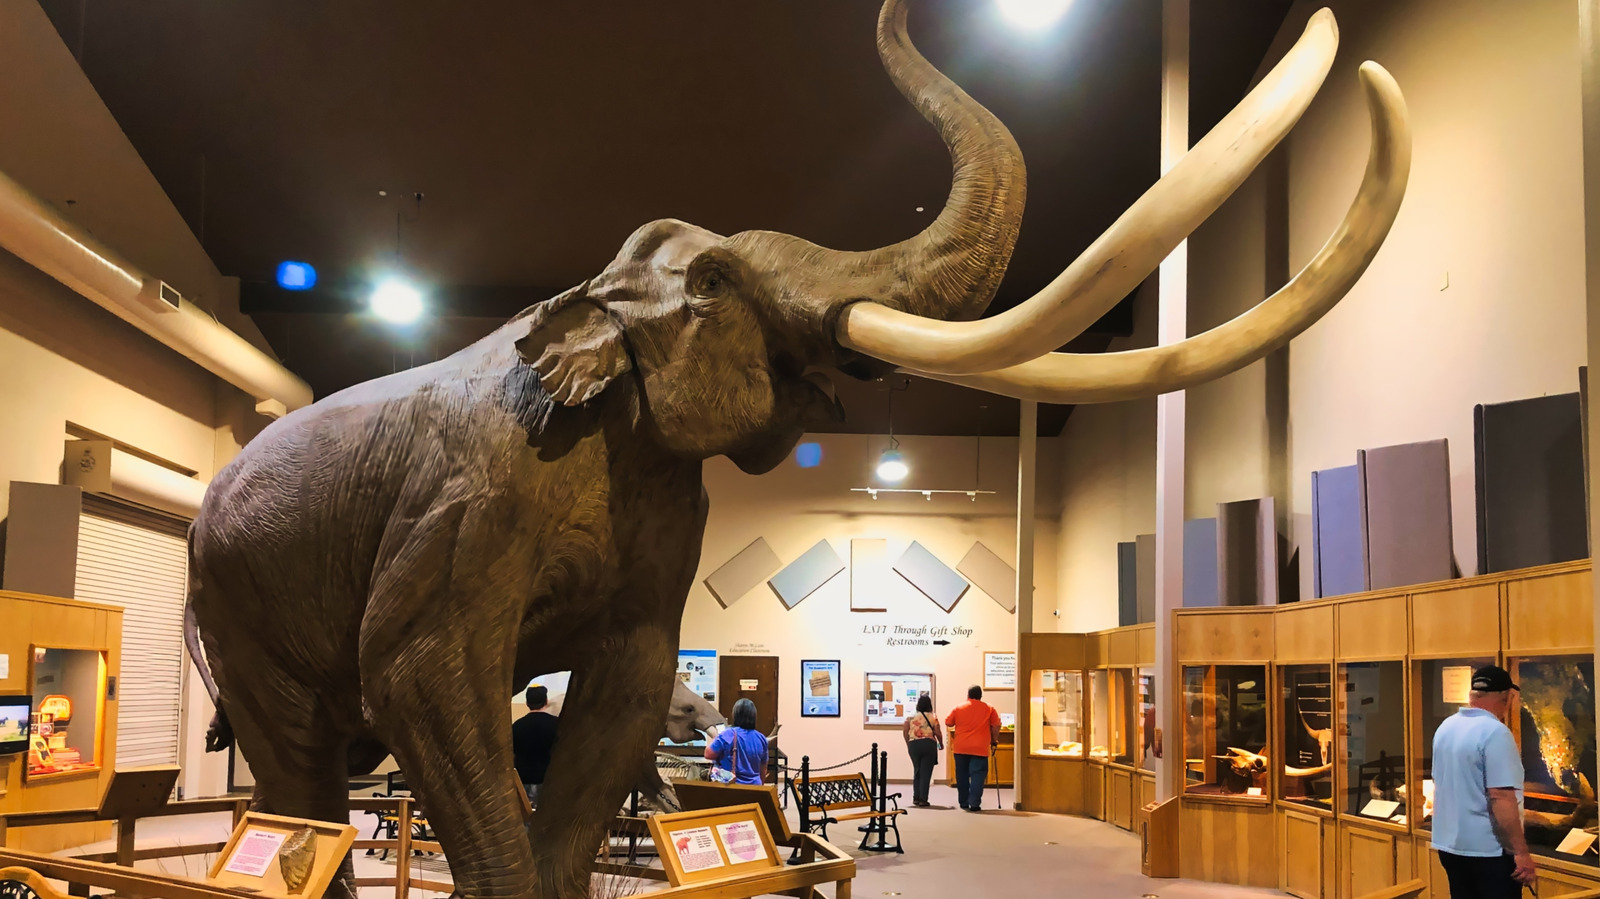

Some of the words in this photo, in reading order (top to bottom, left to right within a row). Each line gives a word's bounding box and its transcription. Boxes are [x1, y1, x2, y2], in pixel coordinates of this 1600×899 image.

[894, 625, 927, 636] Through
[930, 626, 948, 637] Gift
[951, 626, 973, 638] Shop
[887, 637, 929, 646] Restrooms
